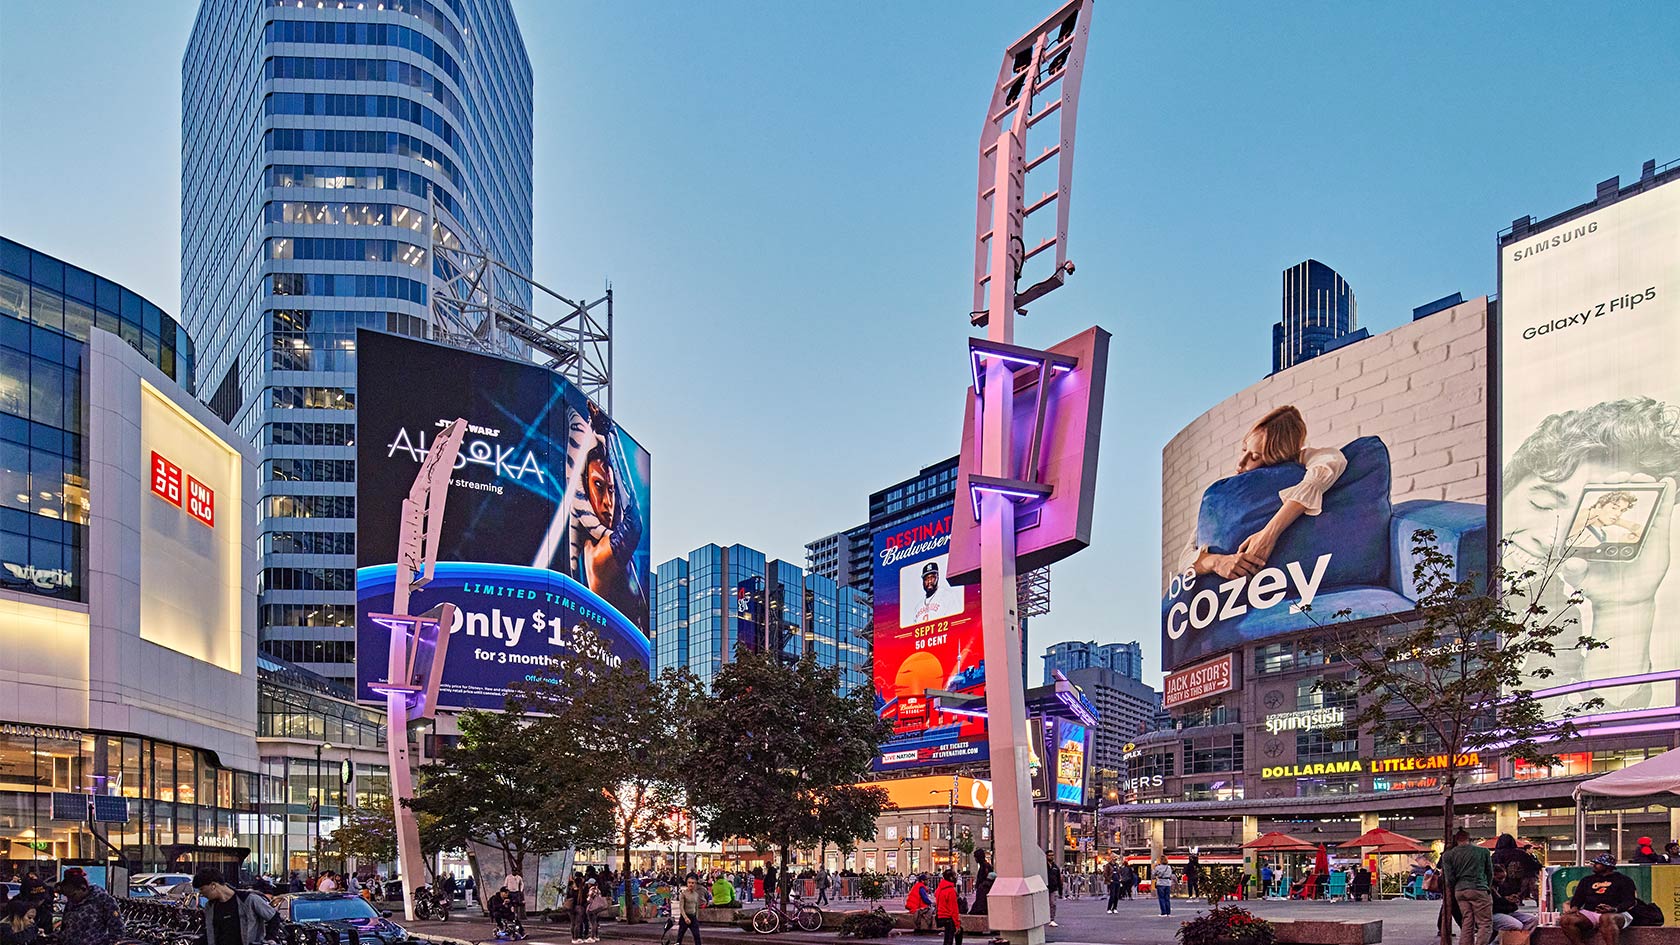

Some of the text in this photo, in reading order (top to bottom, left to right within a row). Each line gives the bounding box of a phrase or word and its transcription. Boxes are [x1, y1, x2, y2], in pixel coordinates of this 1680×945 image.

[1513, 221, 1598, 262] SAMSUNG
[1522, 286, 1656, 340] Galaxy Z Flip5
[435, 419, 500, 437] ST WARS
[156, 458, 179, 485] ユニ
[155, 475, 179, 502] クロ
[455, 478, 504, 495] streaming
[886, 514, 953, 551] DESTINAT
[879, 533, 953, 567] Budweiser
[1167, 553, 1333, 640] cozey
[1168, 567, 1197, 600] be
[463, 582, 607, 627] LIMITED TIME OFFER
[434, 602, 525, 647] Only
[914, 621, 949, 639] SEPT 22
[915, 634, 948, 650] 50 CENT
[1442, 641, 1478, 655] Stoe
[474, 648, 559, 668] for 3 months
[1167, 661, 1229, 695] JACK ASTOR'S
[1166, 680, 1217, 704] PARTY IS THIS WAY
[2, 723, 83, 741] AMSUNG
[896, 751, 916, 760] NATION
[1261, 760, 1362, 778] DOLLARAMA
[1415, 752, 1480, 770] CANDA
[197, 836, 238, 848] SAMSUNG
